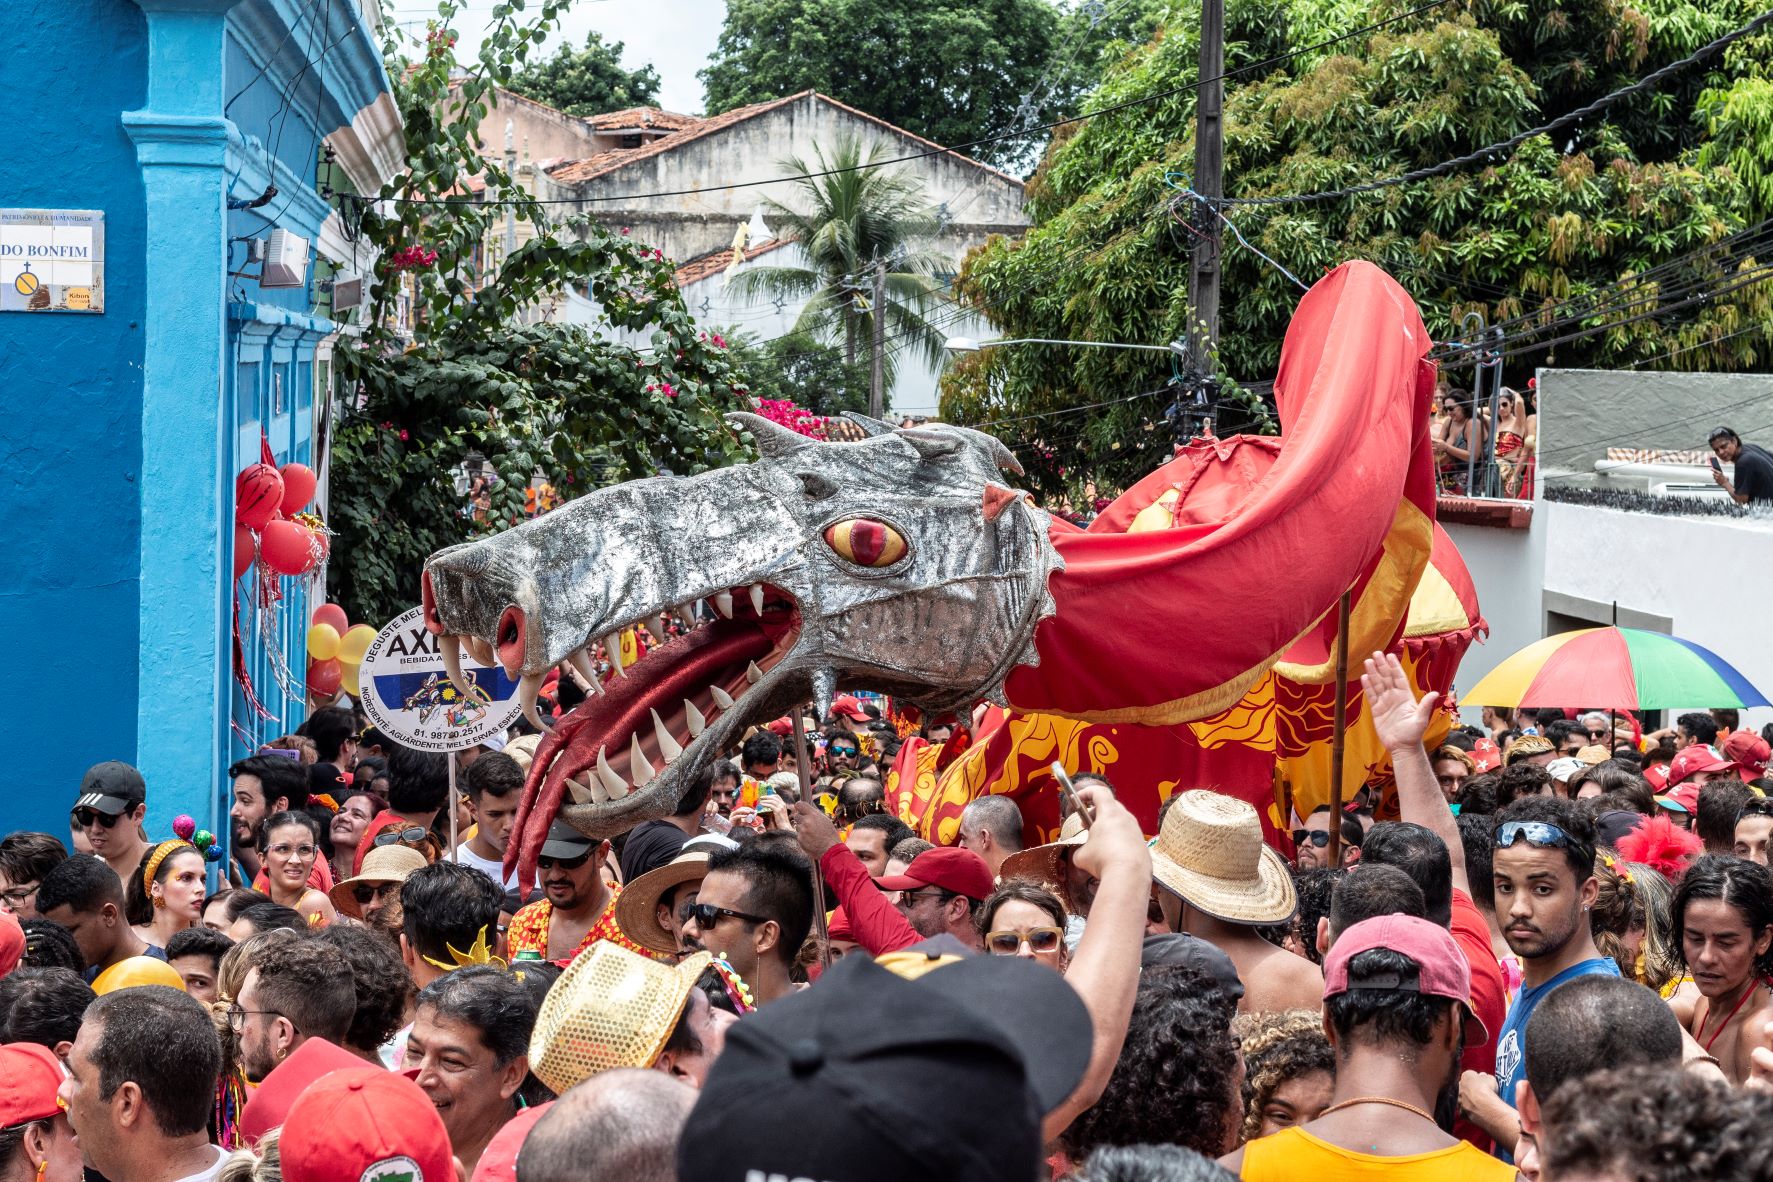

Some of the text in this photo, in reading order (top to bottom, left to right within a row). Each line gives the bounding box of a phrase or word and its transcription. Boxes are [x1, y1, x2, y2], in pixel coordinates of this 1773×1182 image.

[1, 244, 88, 257] DO BONFIM
[365, 609, 424, 662] DEGUSTE MEL
[400, 655, 435, 665] BEBIDA
[361, 686, 390, 732] INGREDIENTE:
[446, 740, 465, 750] MEL
[466, 738, 472, 746] E
[472, 727, 499, 743] ERVAS
